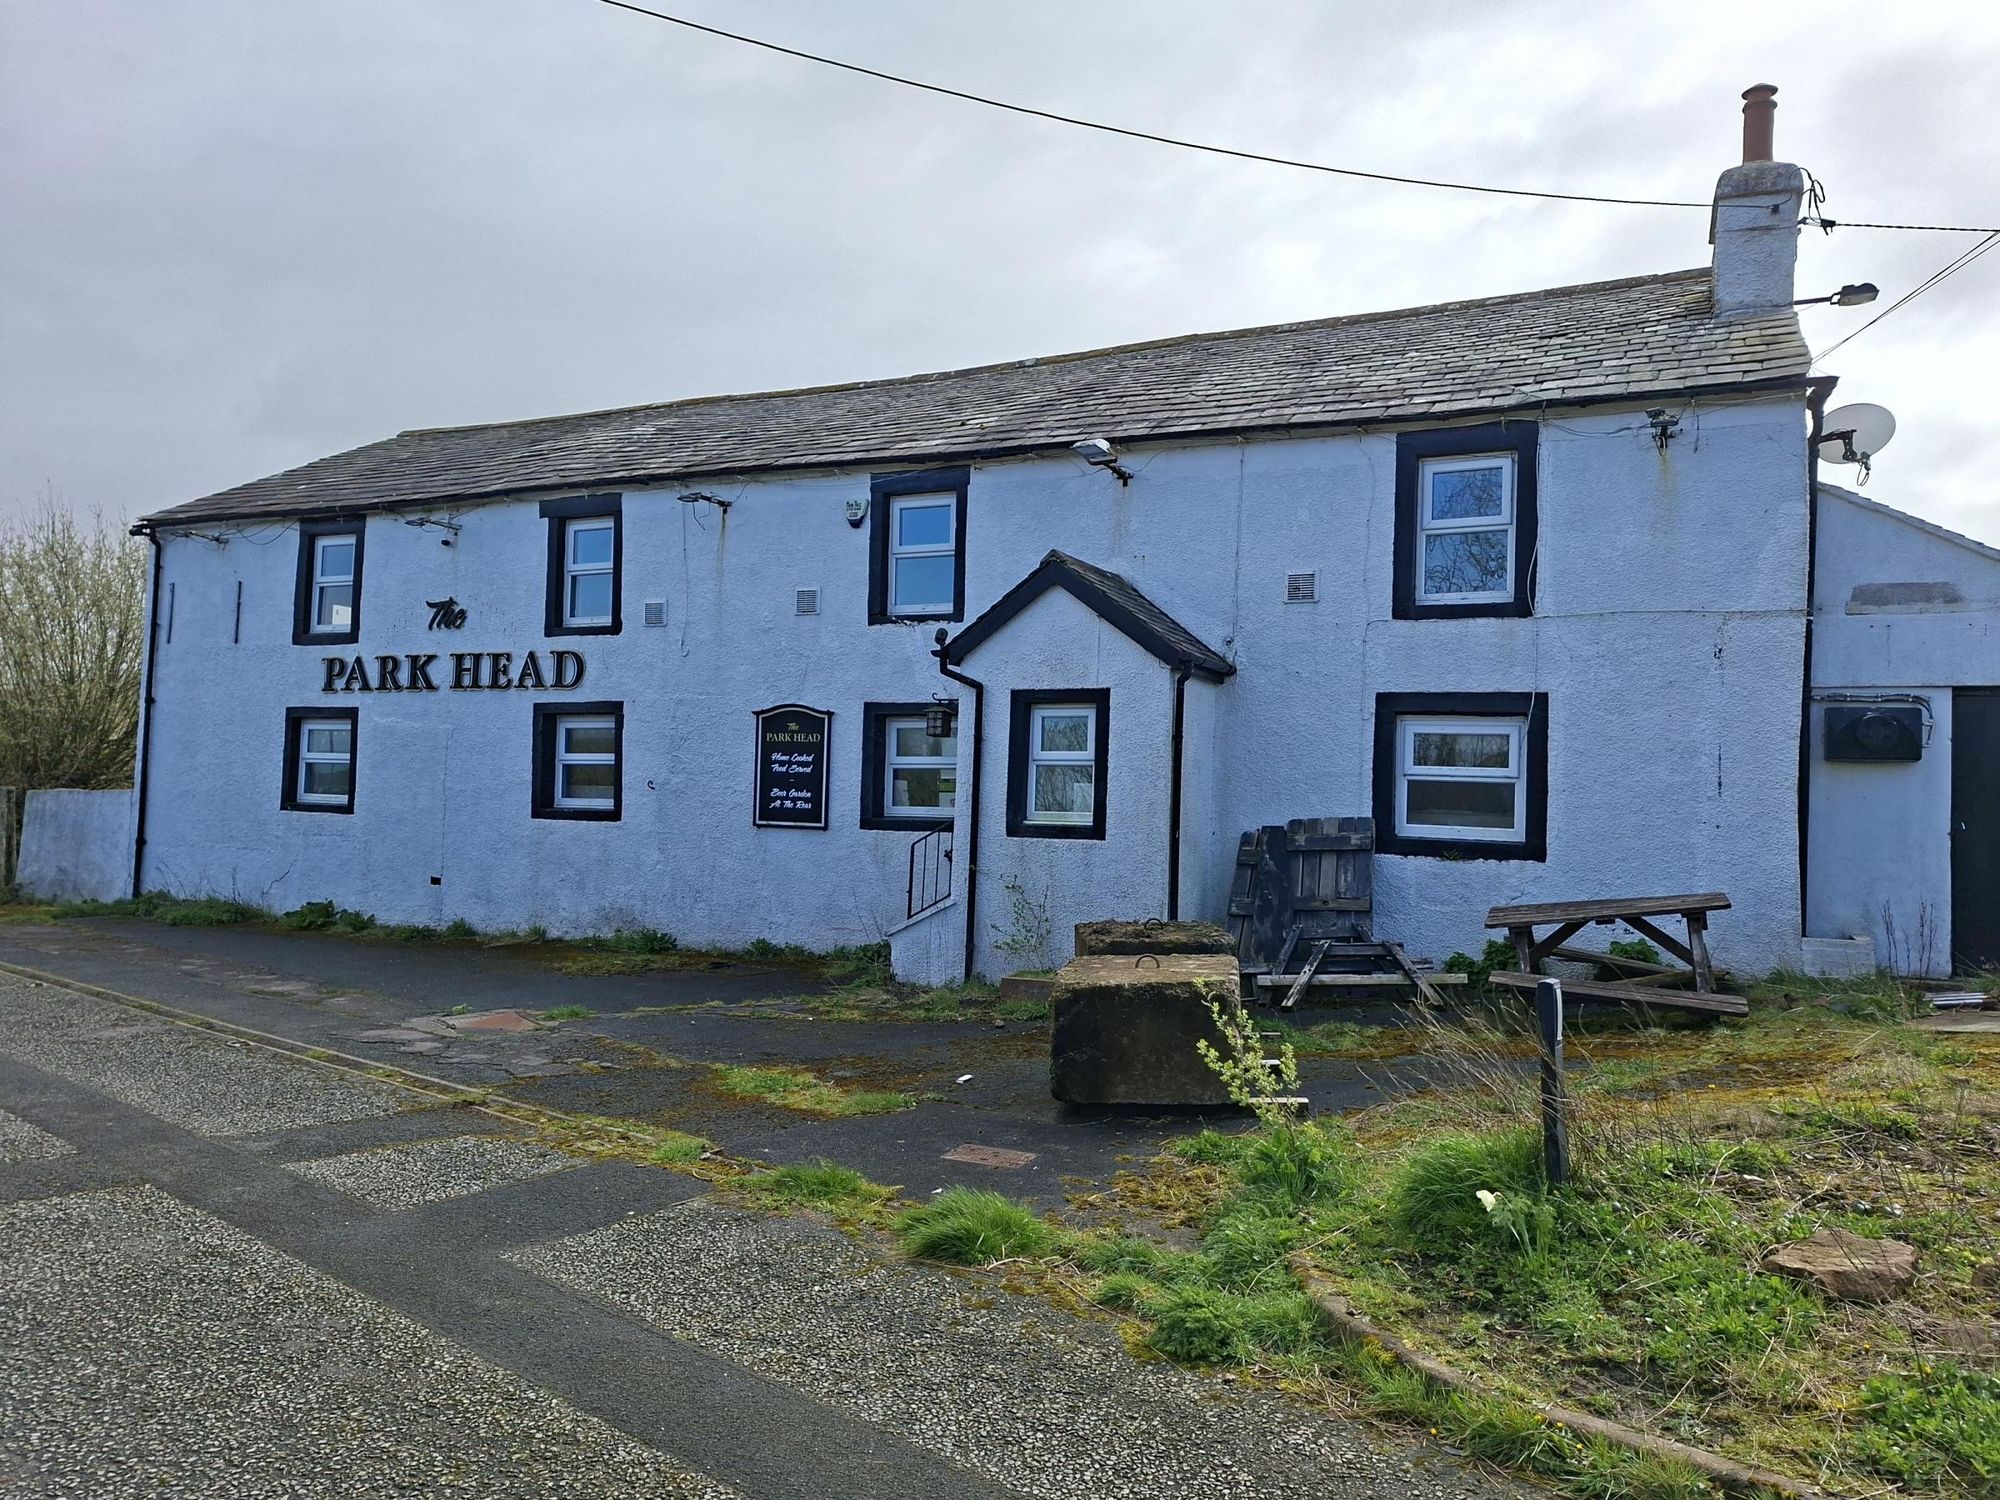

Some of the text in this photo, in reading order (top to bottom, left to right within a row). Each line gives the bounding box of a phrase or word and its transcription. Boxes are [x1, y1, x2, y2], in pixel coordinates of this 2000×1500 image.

[425, 596, 467, 631] The
[321, 650, 586, 693] PARK HEAD
[787, 722, 799, 731] The
[766, 732, 820, 743] PARK HEAD
[771, 752, 814, 762] Home Cooked
[771, 763, 813, 773] Food Served
[770, 788, 811, 798] Beer Garden
[769, 799, 811, 809] At The Rear
